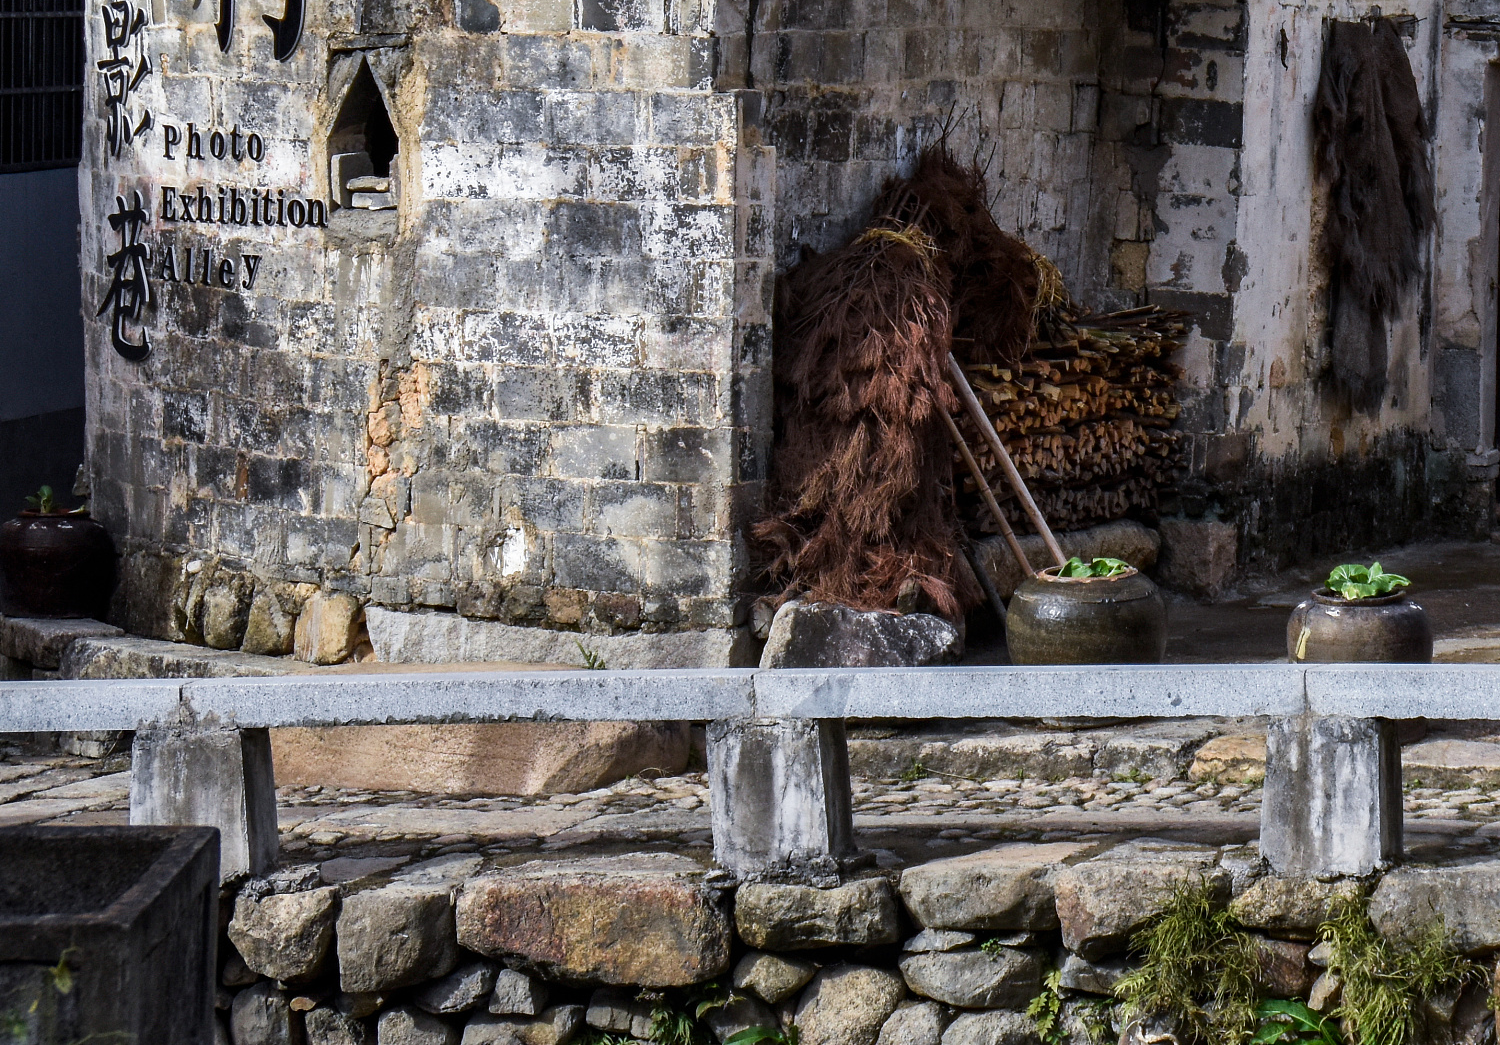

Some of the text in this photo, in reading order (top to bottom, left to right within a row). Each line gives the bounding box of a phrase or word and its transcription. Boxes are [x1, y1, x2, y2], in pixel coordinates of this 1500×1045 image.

[162, 122, 266, 162] Photo
[159, 185, 329, 229] Exhibition
[159, 246, 263, 290] Alley
